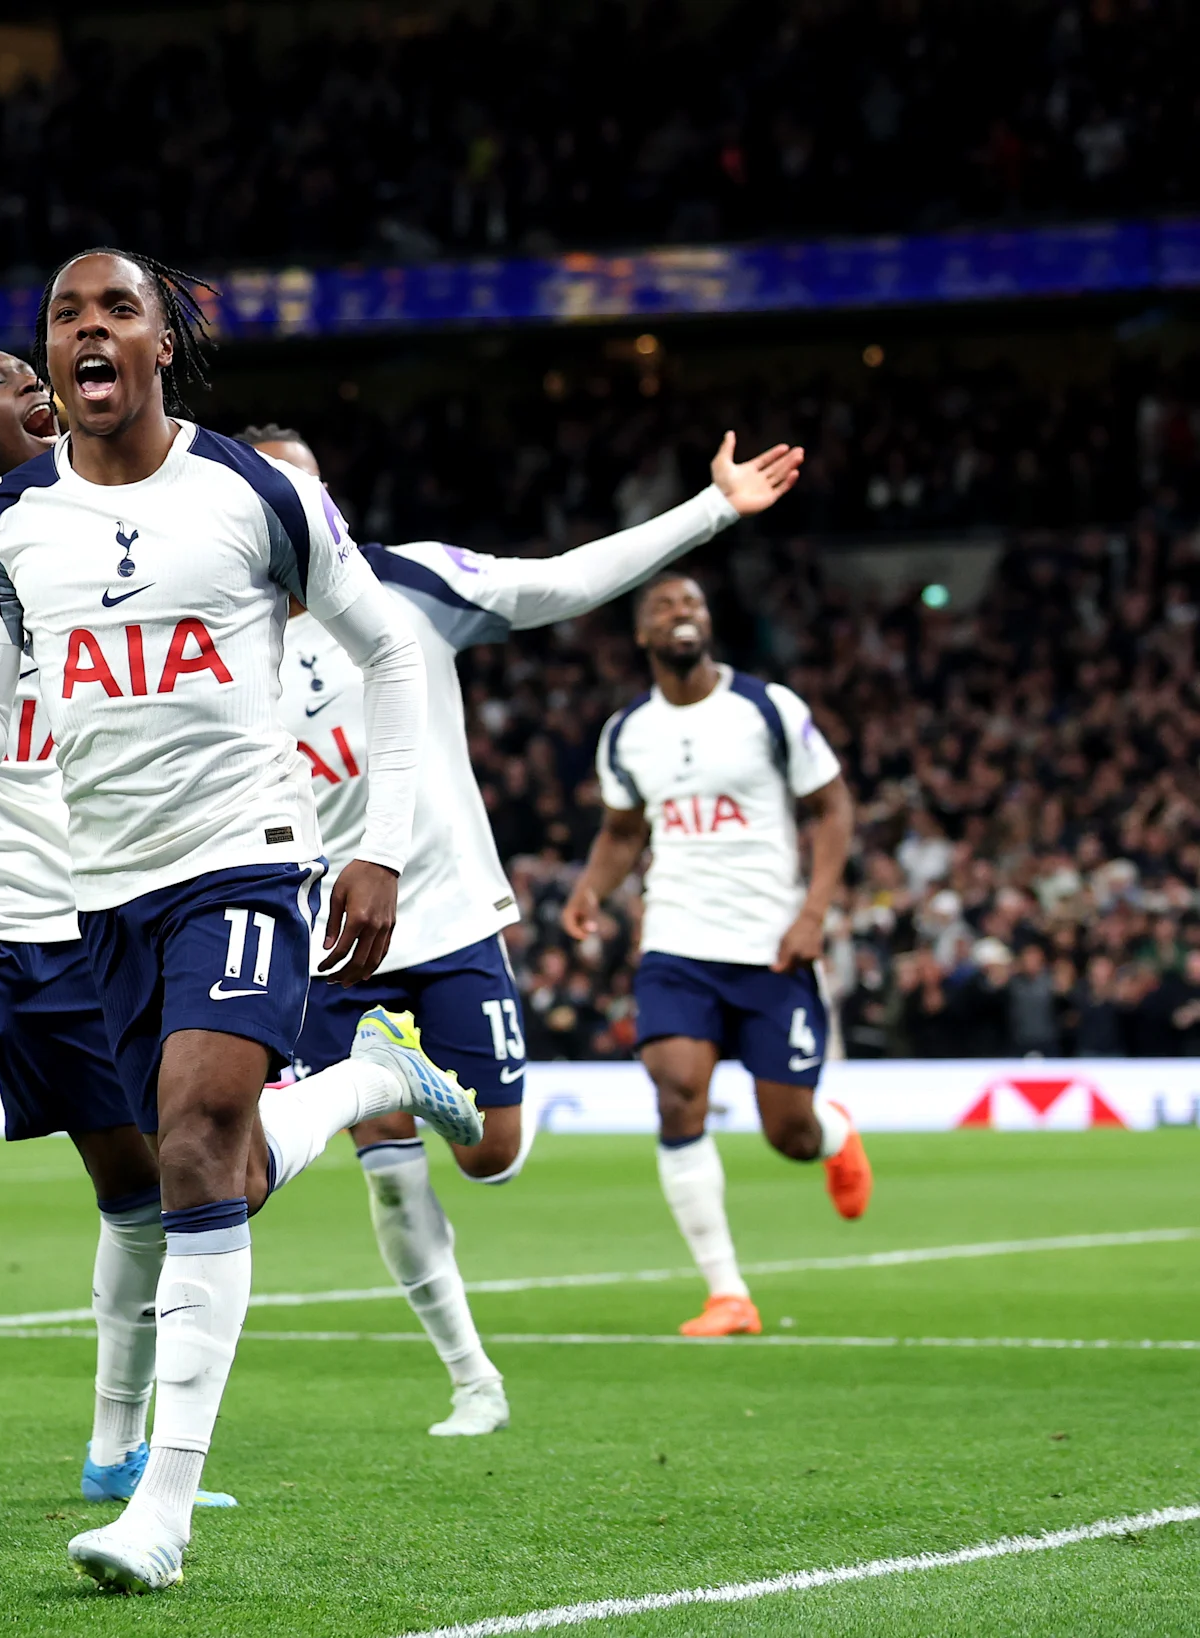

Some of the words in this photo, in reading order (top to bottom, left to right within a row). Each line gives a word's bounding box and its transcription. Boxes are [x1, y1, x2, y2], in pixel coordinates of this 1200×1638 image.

[62, 618, 233, 699] AIA
[296, 726, 360, 785] AI
[662, 794, 750, 834] AIA
[223, 906, 276, 987] 11
[481, 998, 526, 1061] 13
[788, 1007, 816, 1057] 4
